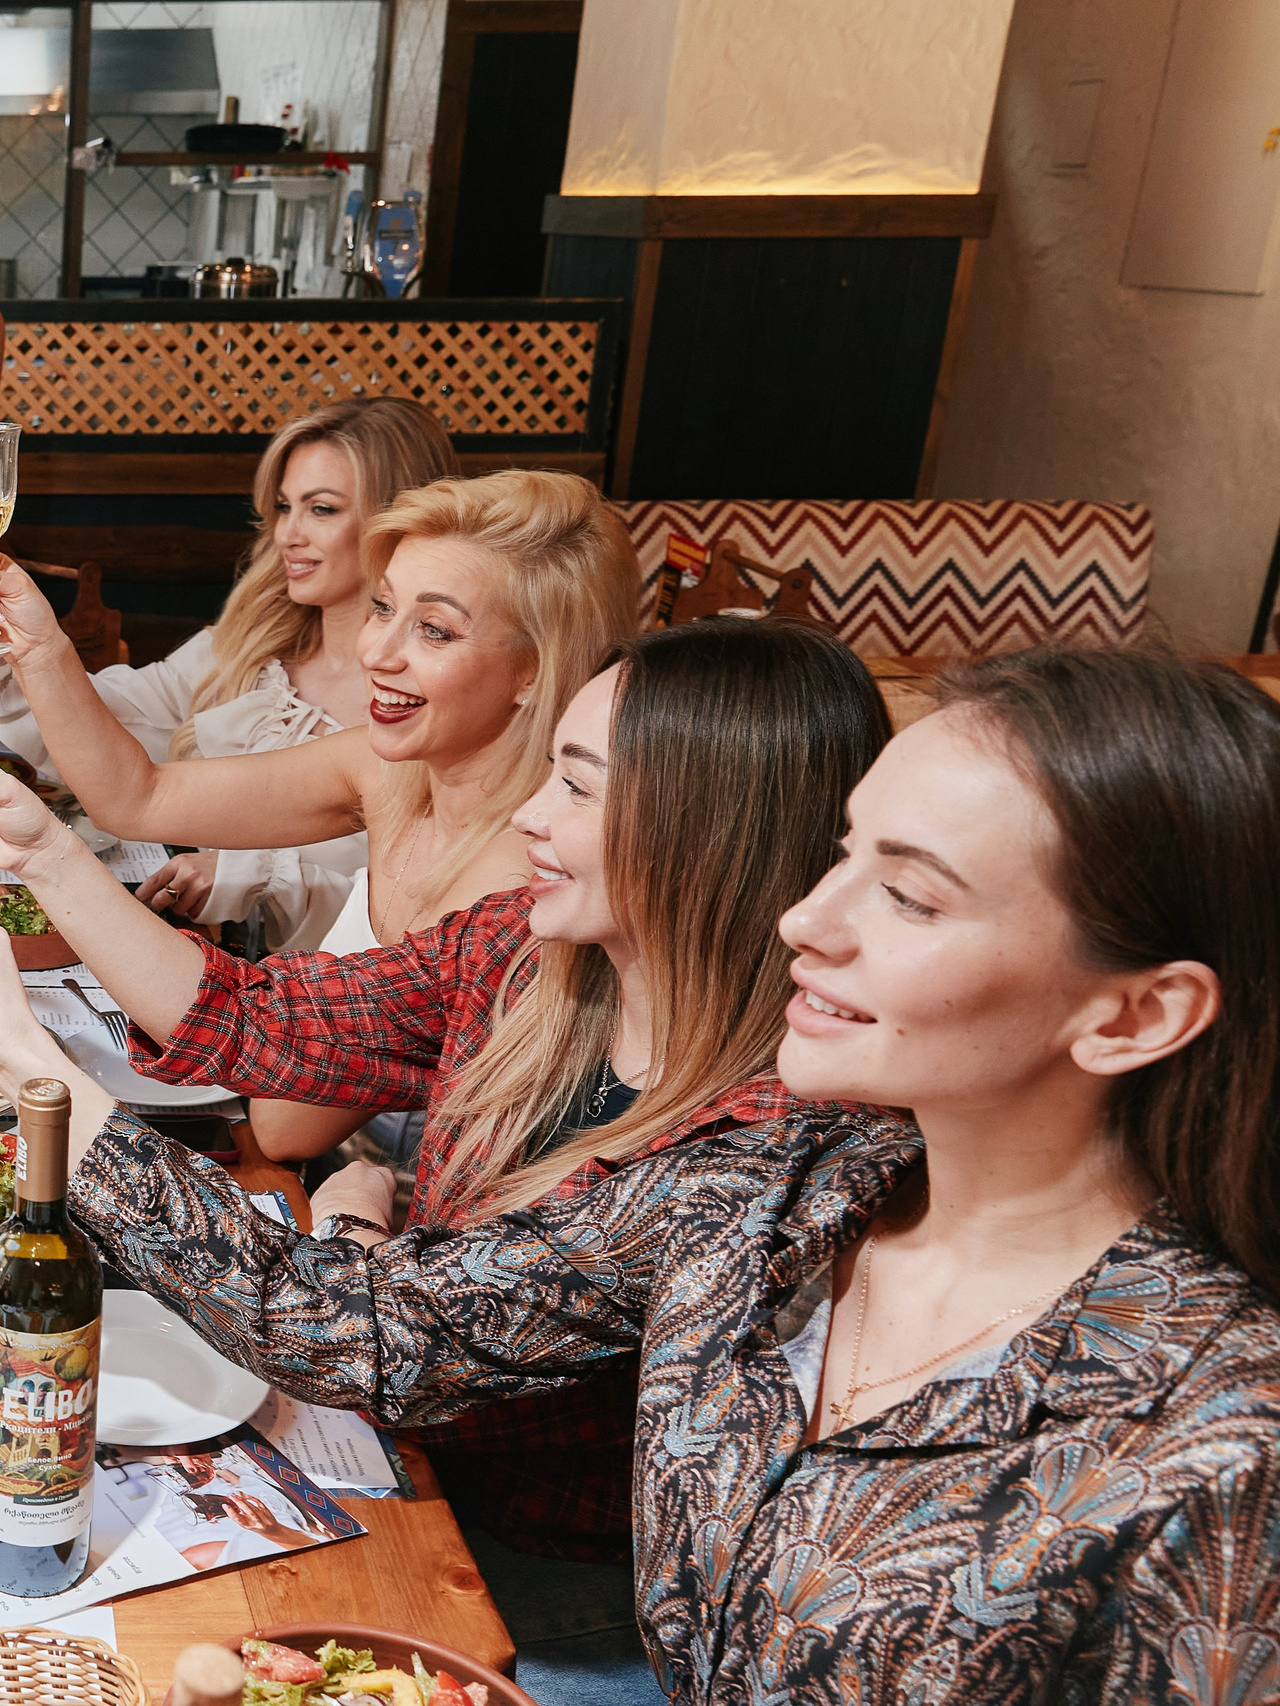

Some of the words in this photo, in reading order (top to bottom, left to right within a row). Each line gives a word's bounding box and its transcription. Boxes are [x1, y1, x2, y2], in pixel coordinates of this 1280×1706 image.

[17, 1135, 29, 1182] ELIBO
[2, 1378, 93, 1423] ELIBO
[0, 1420, 56, 1434] Ркацители
[27, 1456, 52, 1464] Белое
[38, 1463, 62, 1471] Сухое
